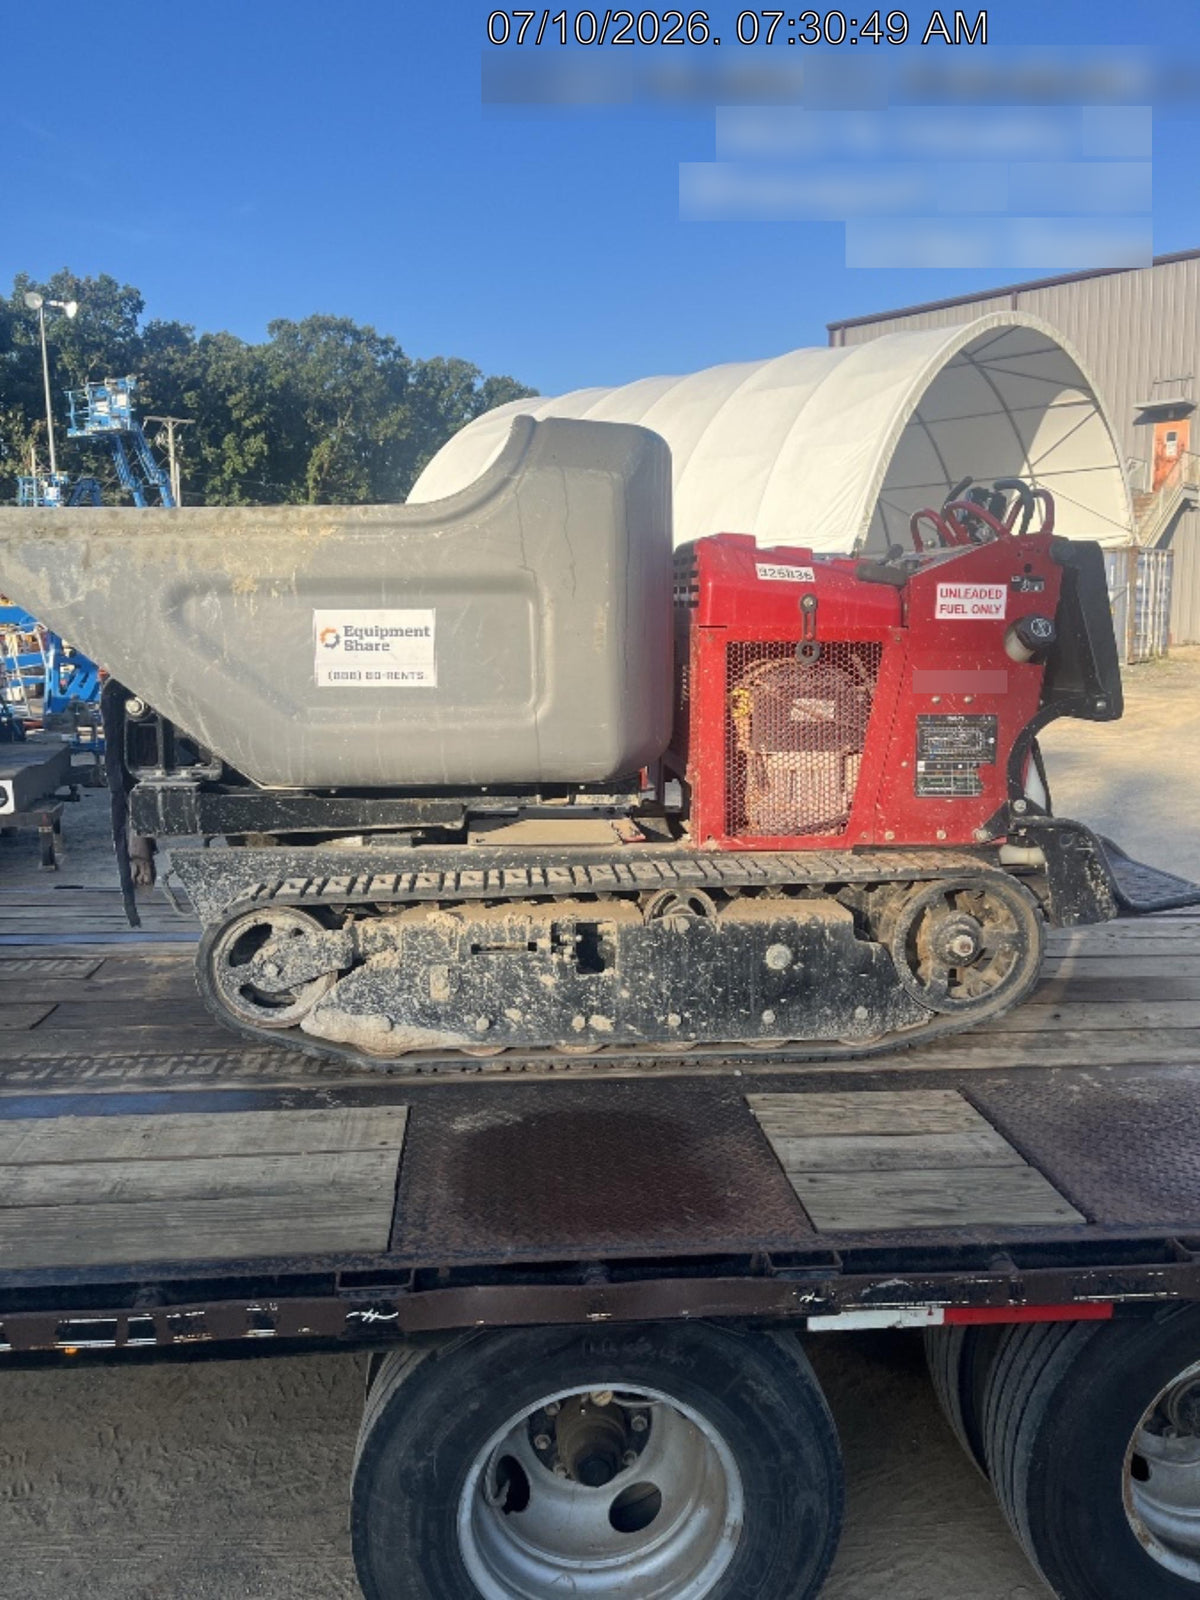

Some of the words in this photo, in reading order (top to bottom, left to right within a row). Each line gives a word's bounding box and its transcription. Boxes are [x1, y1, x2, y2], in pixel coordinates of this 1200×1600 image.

[940, 588, 1003, 600] UNLEADED
[939, 604, 967, 614] FUEL
[972, 604, 1002, 614] ONLY
[343, 625, 431, 640] Equipment
[344, 640, 390, 651] Share
